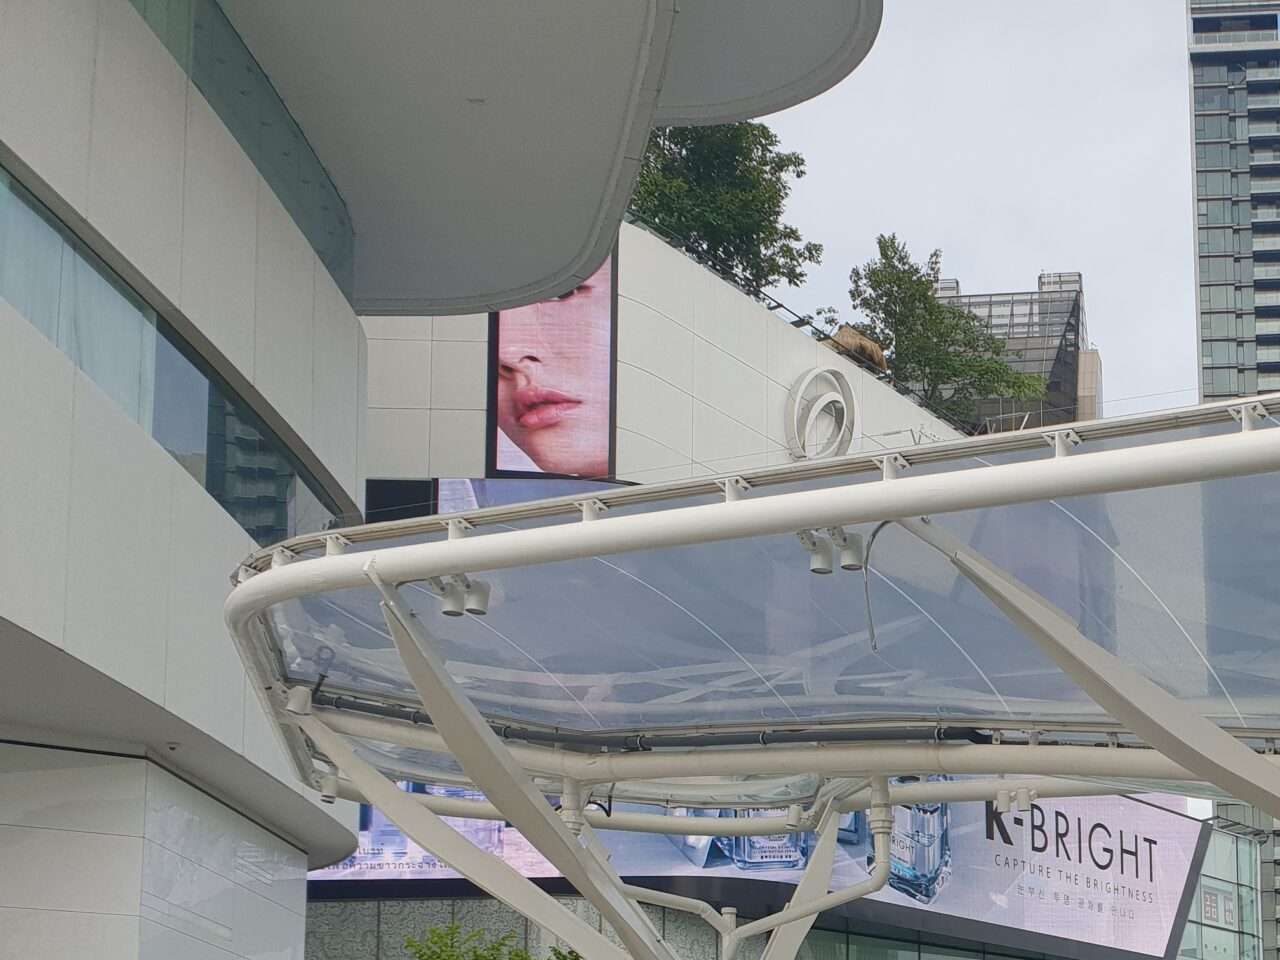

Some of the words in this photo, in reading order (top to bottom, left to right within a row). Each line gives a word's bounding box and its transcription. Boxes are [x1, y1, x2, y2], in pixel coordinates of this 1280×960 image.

[985, 800, 1158, 883] K-BRIGHT
[994, 853, 1052, 879] CAPTURE
[1058, 869, 1080, 886] THE
[1085, 876, 1154, 904] BRIGHTNESS
